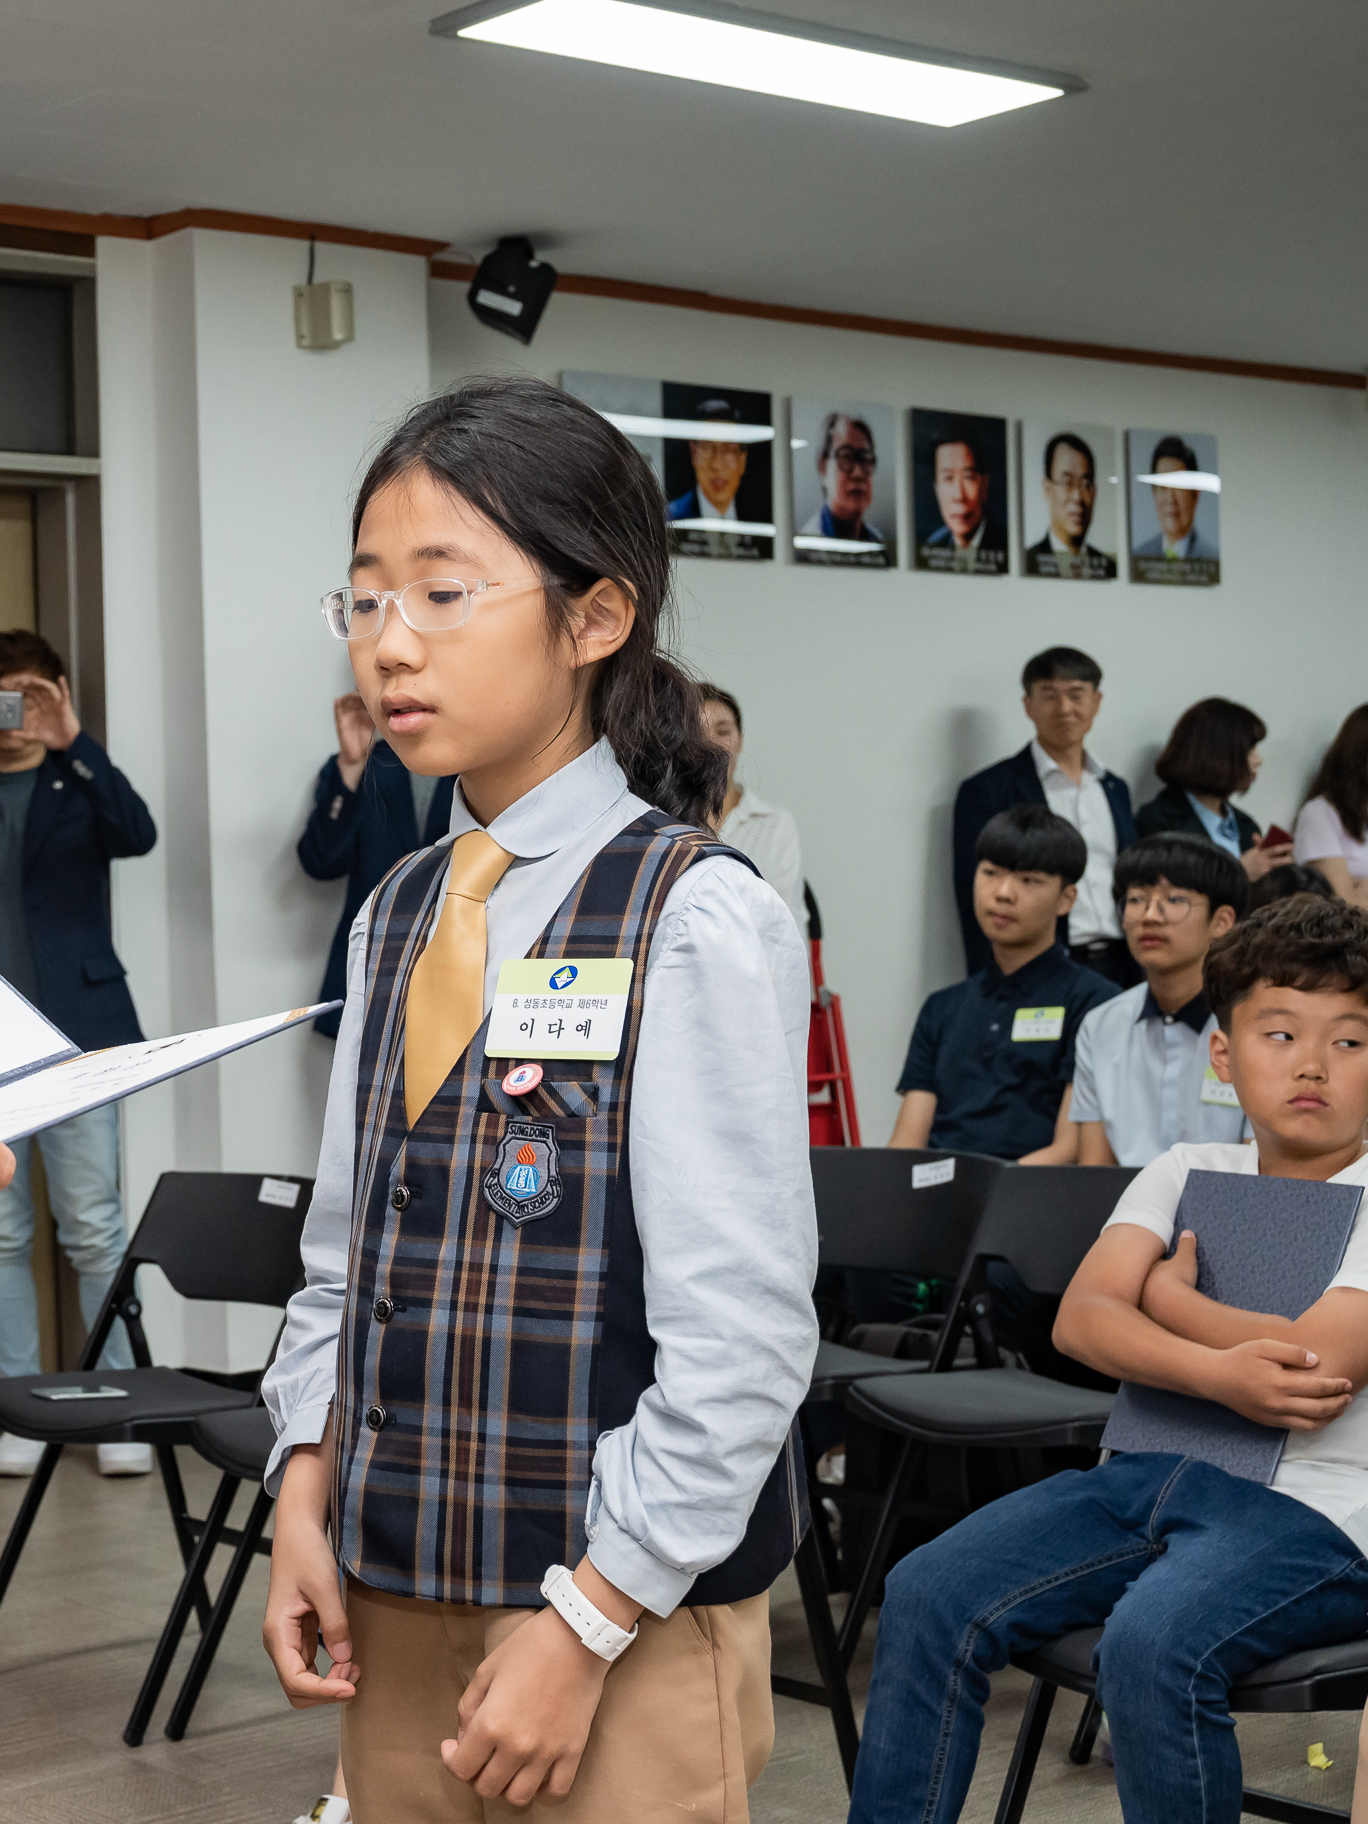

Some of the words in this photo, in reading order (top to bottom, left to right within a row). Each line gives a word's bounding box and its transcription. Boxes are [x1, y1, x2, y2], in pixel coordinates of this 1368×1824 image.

[512, 998, 519, 1009] 8.
[524, 998, 573, 1010] 성동초등학교
[577, 998, 608, 1010] 제6학년
